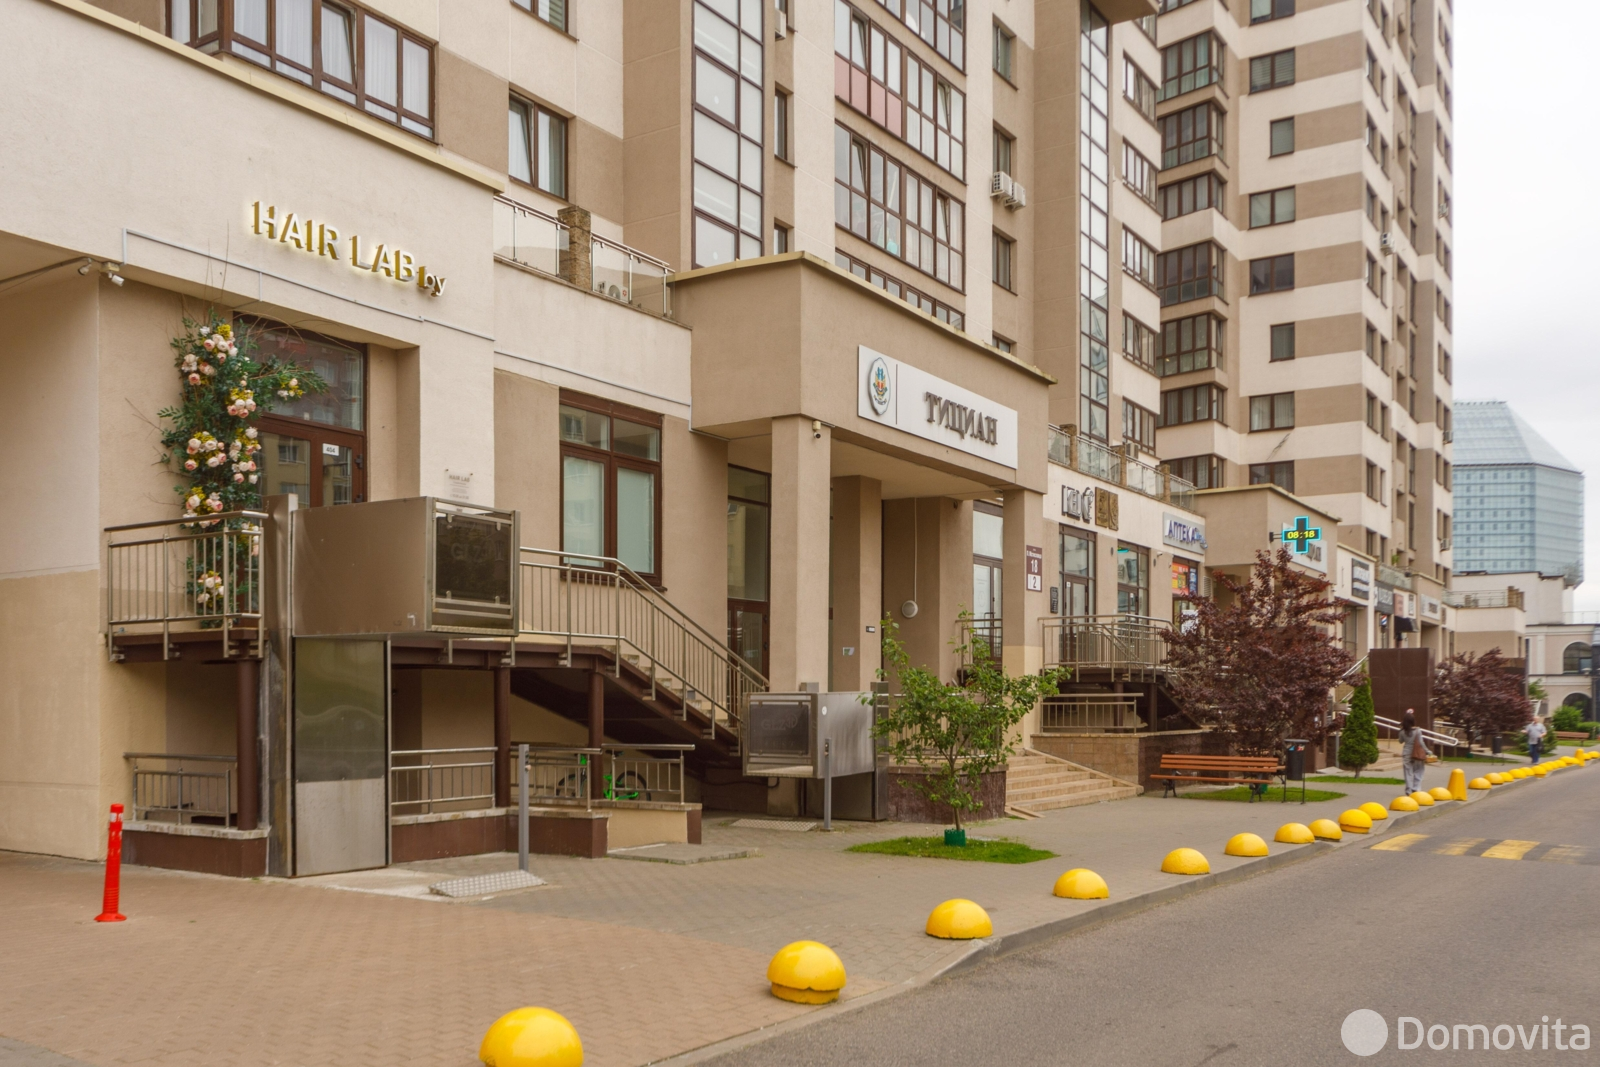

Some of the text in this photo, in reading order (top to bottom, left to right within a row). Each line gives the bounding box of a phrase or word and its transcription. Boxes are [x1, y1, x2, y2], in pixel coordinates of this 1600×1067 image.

[254, 201, 447, 297] HAIR LAB by
[925, 391, 998, 445] ТИЦИАН
[1165, 519, 1196, 544] АПТЕКА
[1287, 530, 1315, 539] 08:18
[1030, 559, 1038, 573] 18
[1032, 576, 1037, 589] 2
